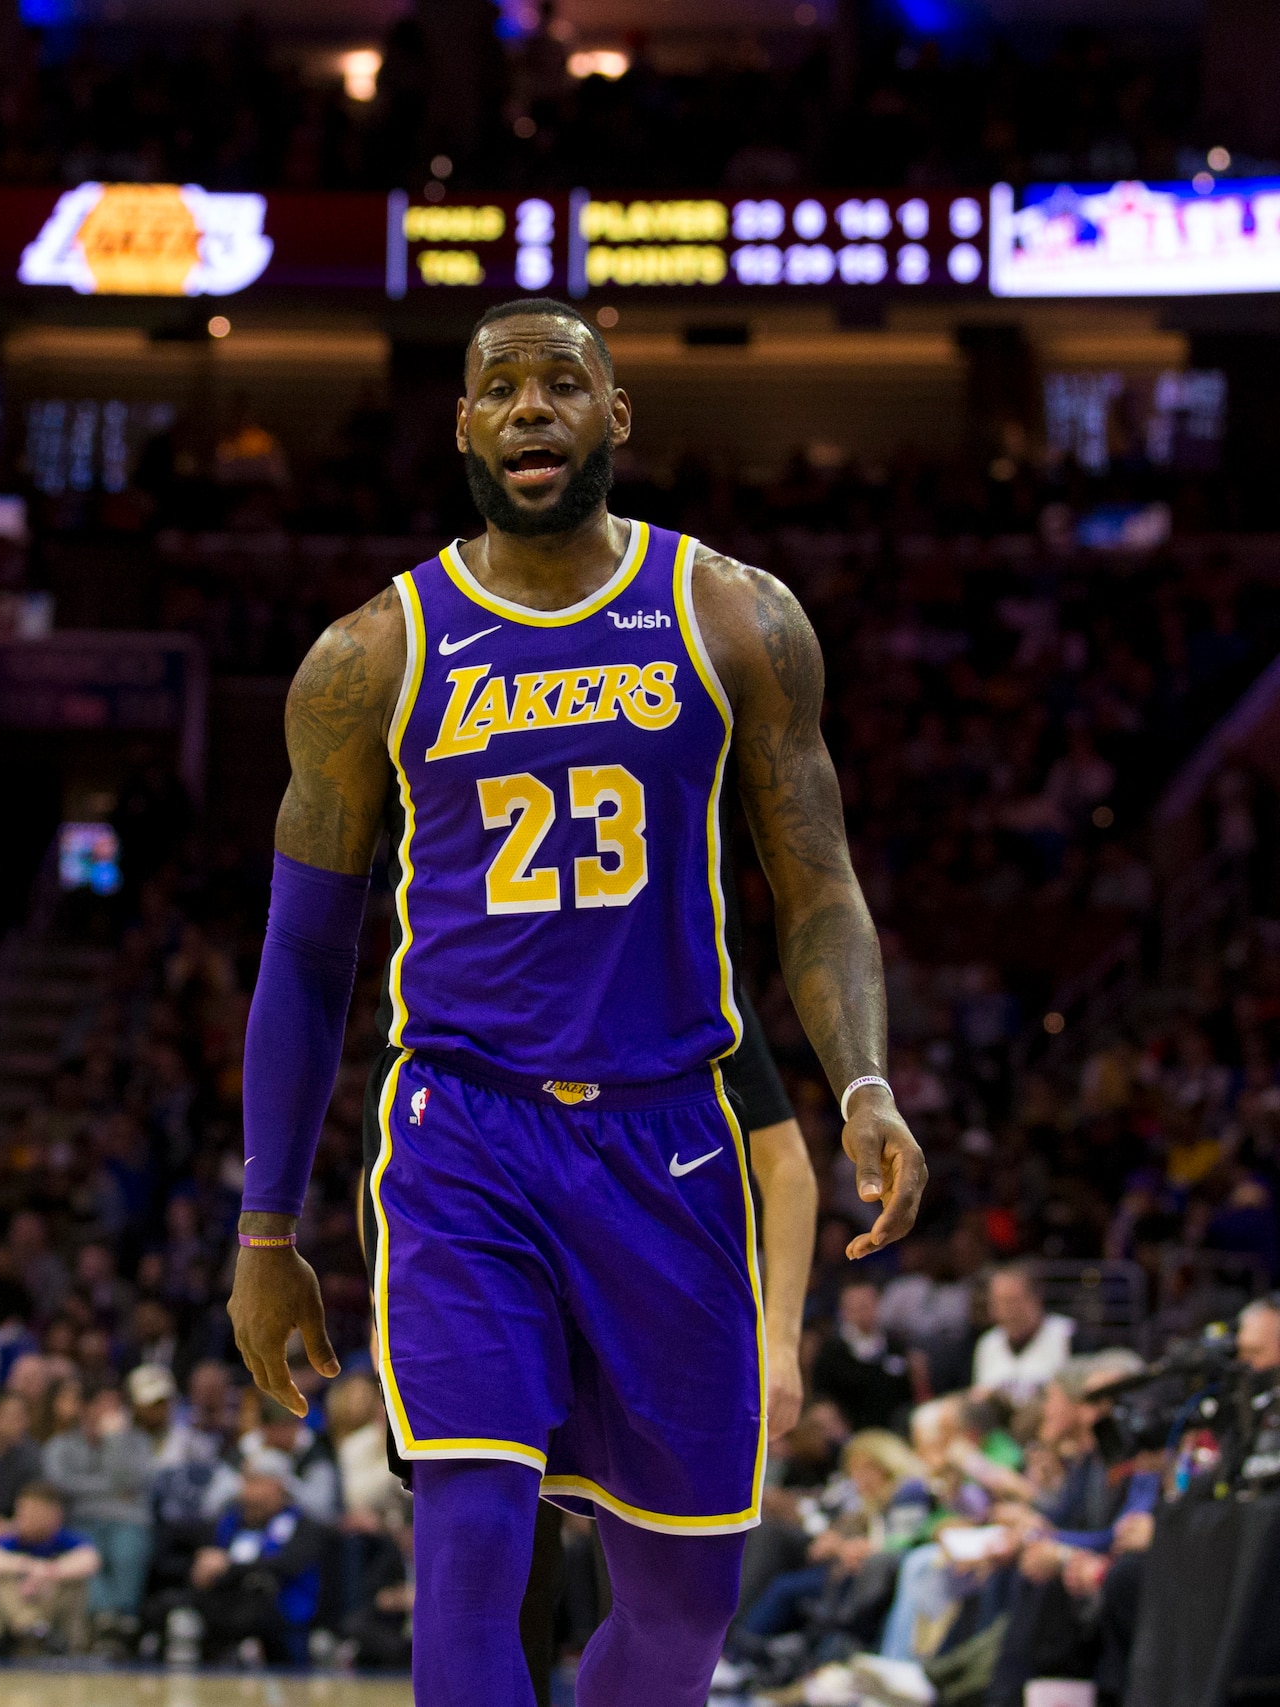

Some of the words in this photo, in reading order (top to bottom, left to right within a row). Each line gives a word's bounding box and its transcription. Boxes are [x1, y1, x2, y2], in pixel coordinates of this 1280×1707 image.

[607, 609, 672, 629] wish
[425, 661, 682, 763] LAKERS
[476, 764, 649, 916] 23
[541, 1079, 601, 1103] LAKERS
[249, 1238, 290, 1246] PROMISE
